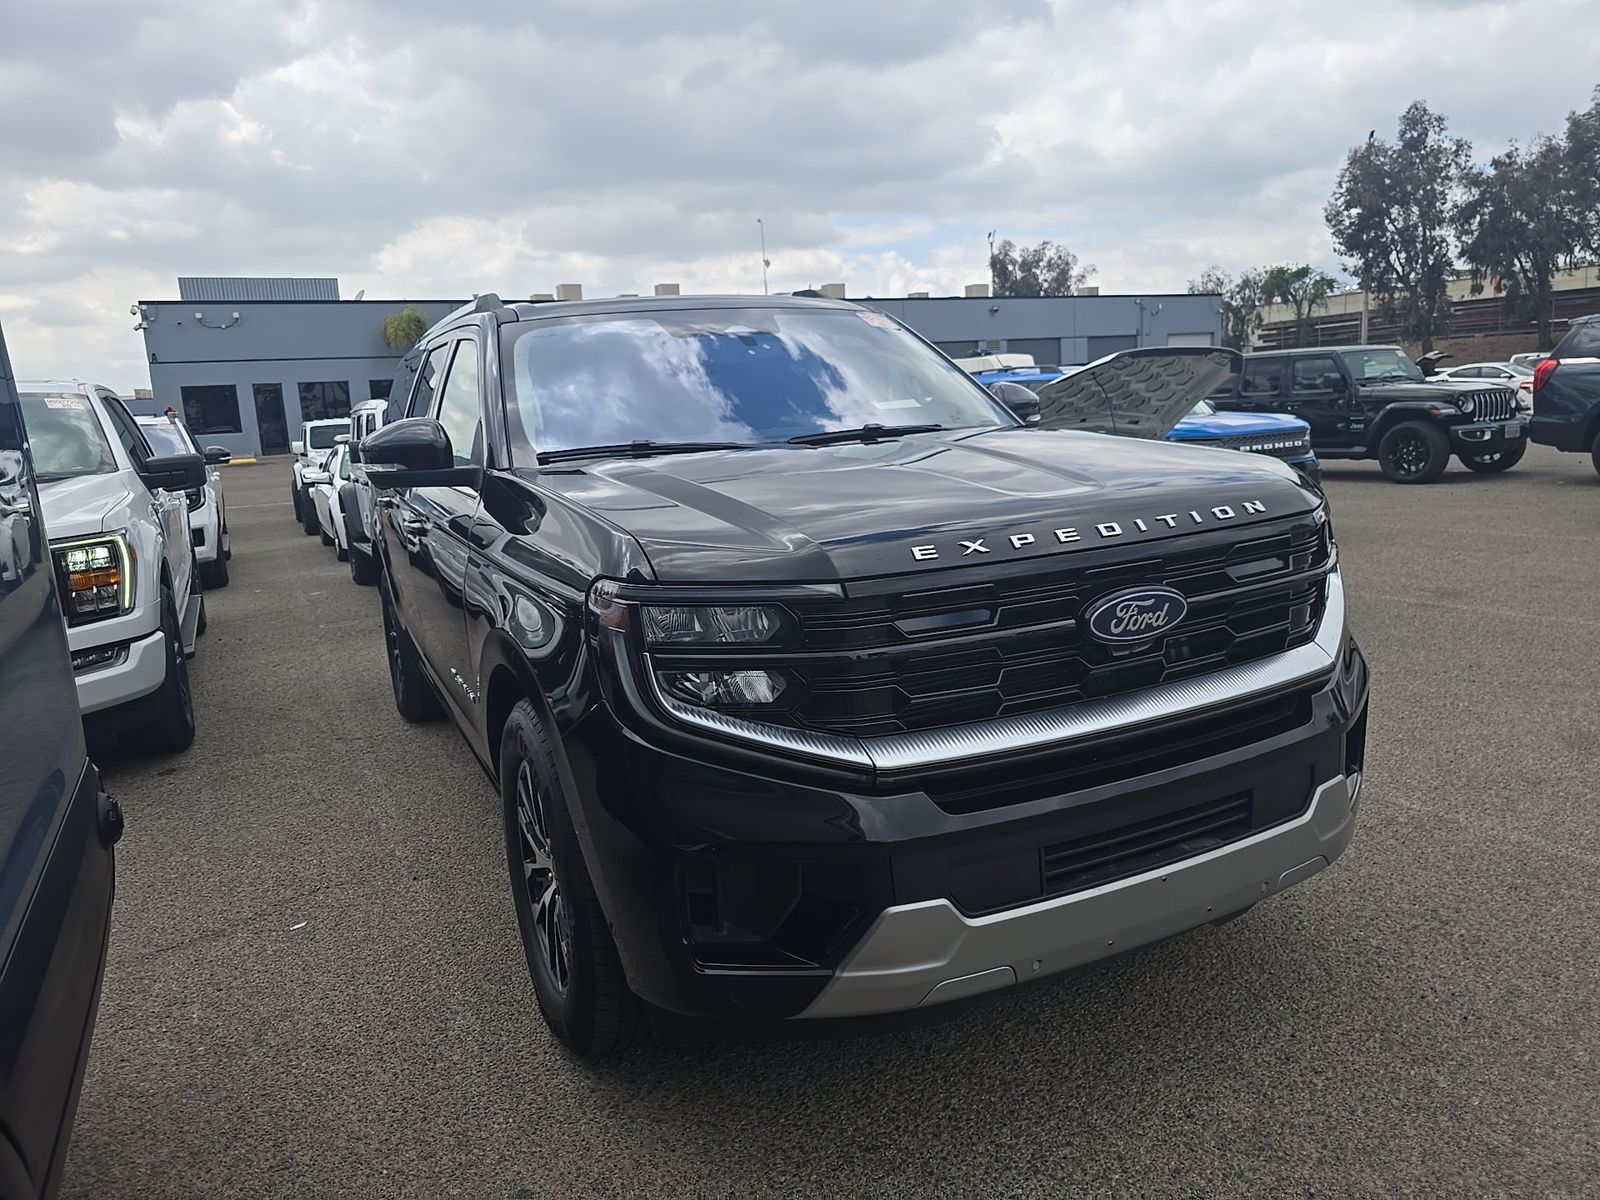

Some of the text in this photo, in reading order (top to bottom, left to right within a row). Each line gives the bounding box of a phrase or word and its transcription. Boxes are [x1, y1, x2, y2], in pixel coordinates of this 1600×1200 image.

[1240, 440, 1302, 452] BRONCO
[910, 500, 1267, 561] EXPEDITION
[1110, 598, 1169, 634] Ford
